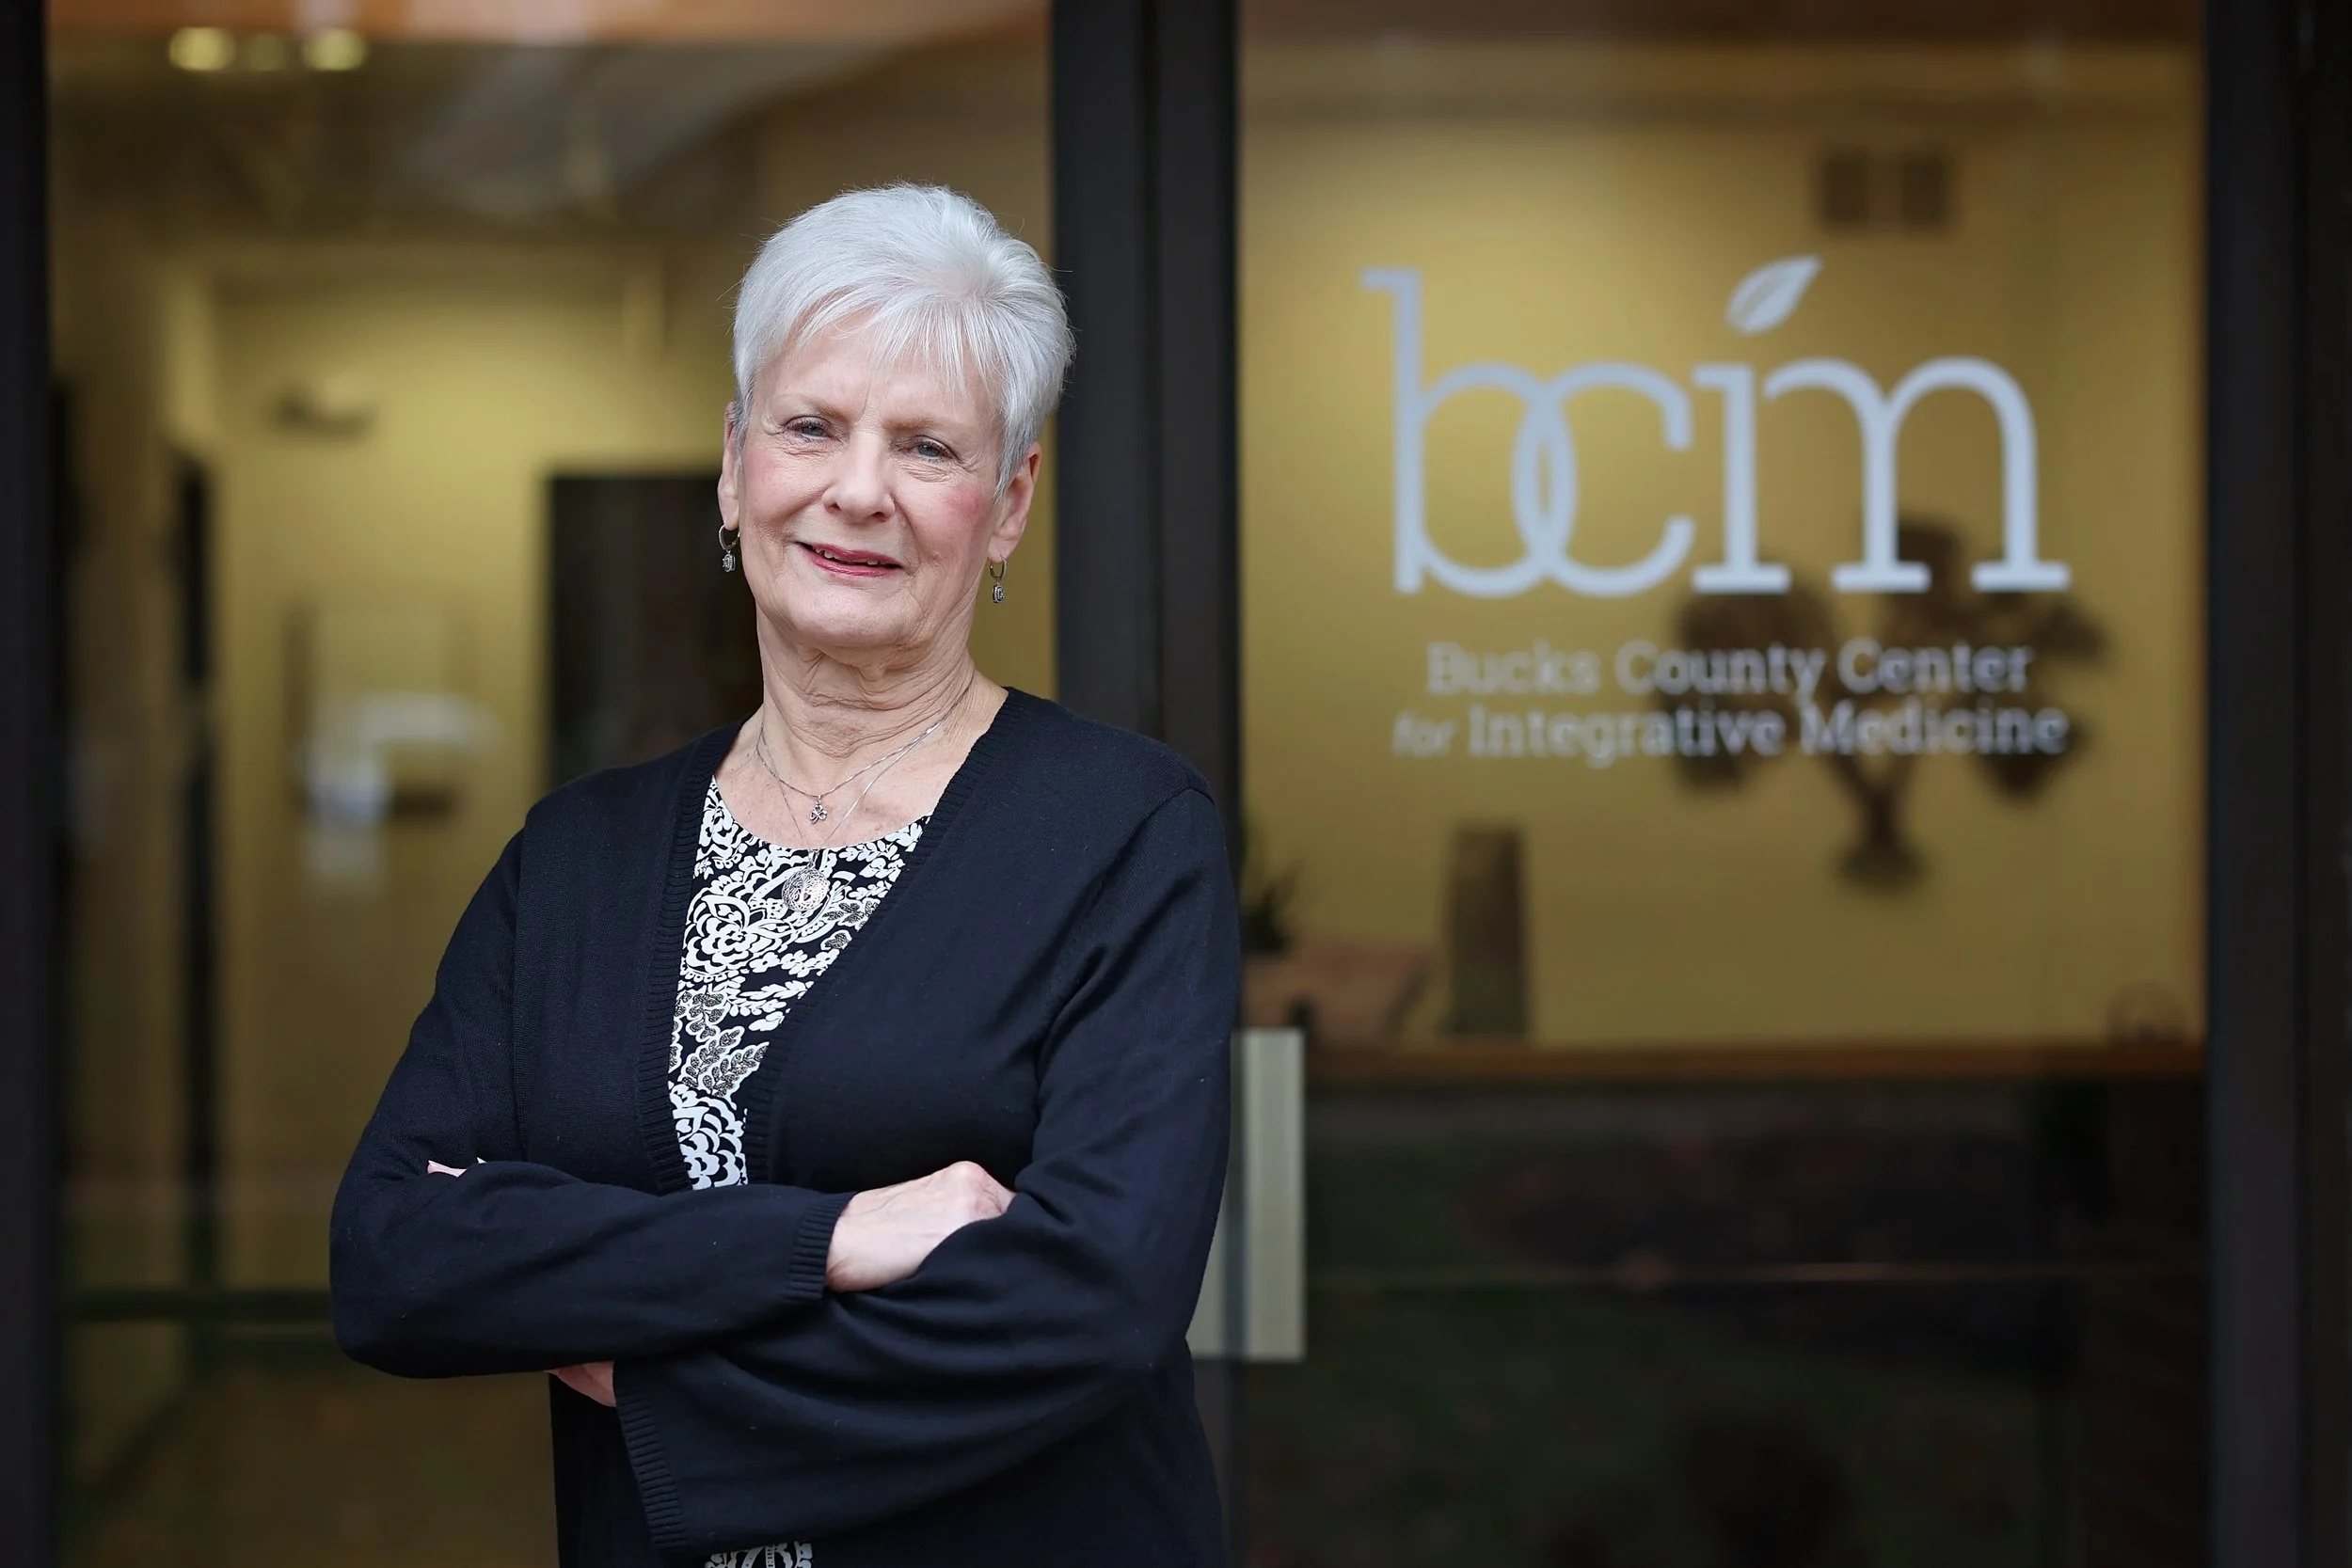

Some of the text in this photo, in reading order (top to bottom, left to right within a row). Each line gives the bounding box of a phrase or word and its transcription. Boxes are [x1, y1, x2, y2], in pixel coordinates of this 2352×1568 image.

[1425, 638, 2033, 712] Bucks County Center
[1392, 700, 2071, 768] for Integrative Medicine
